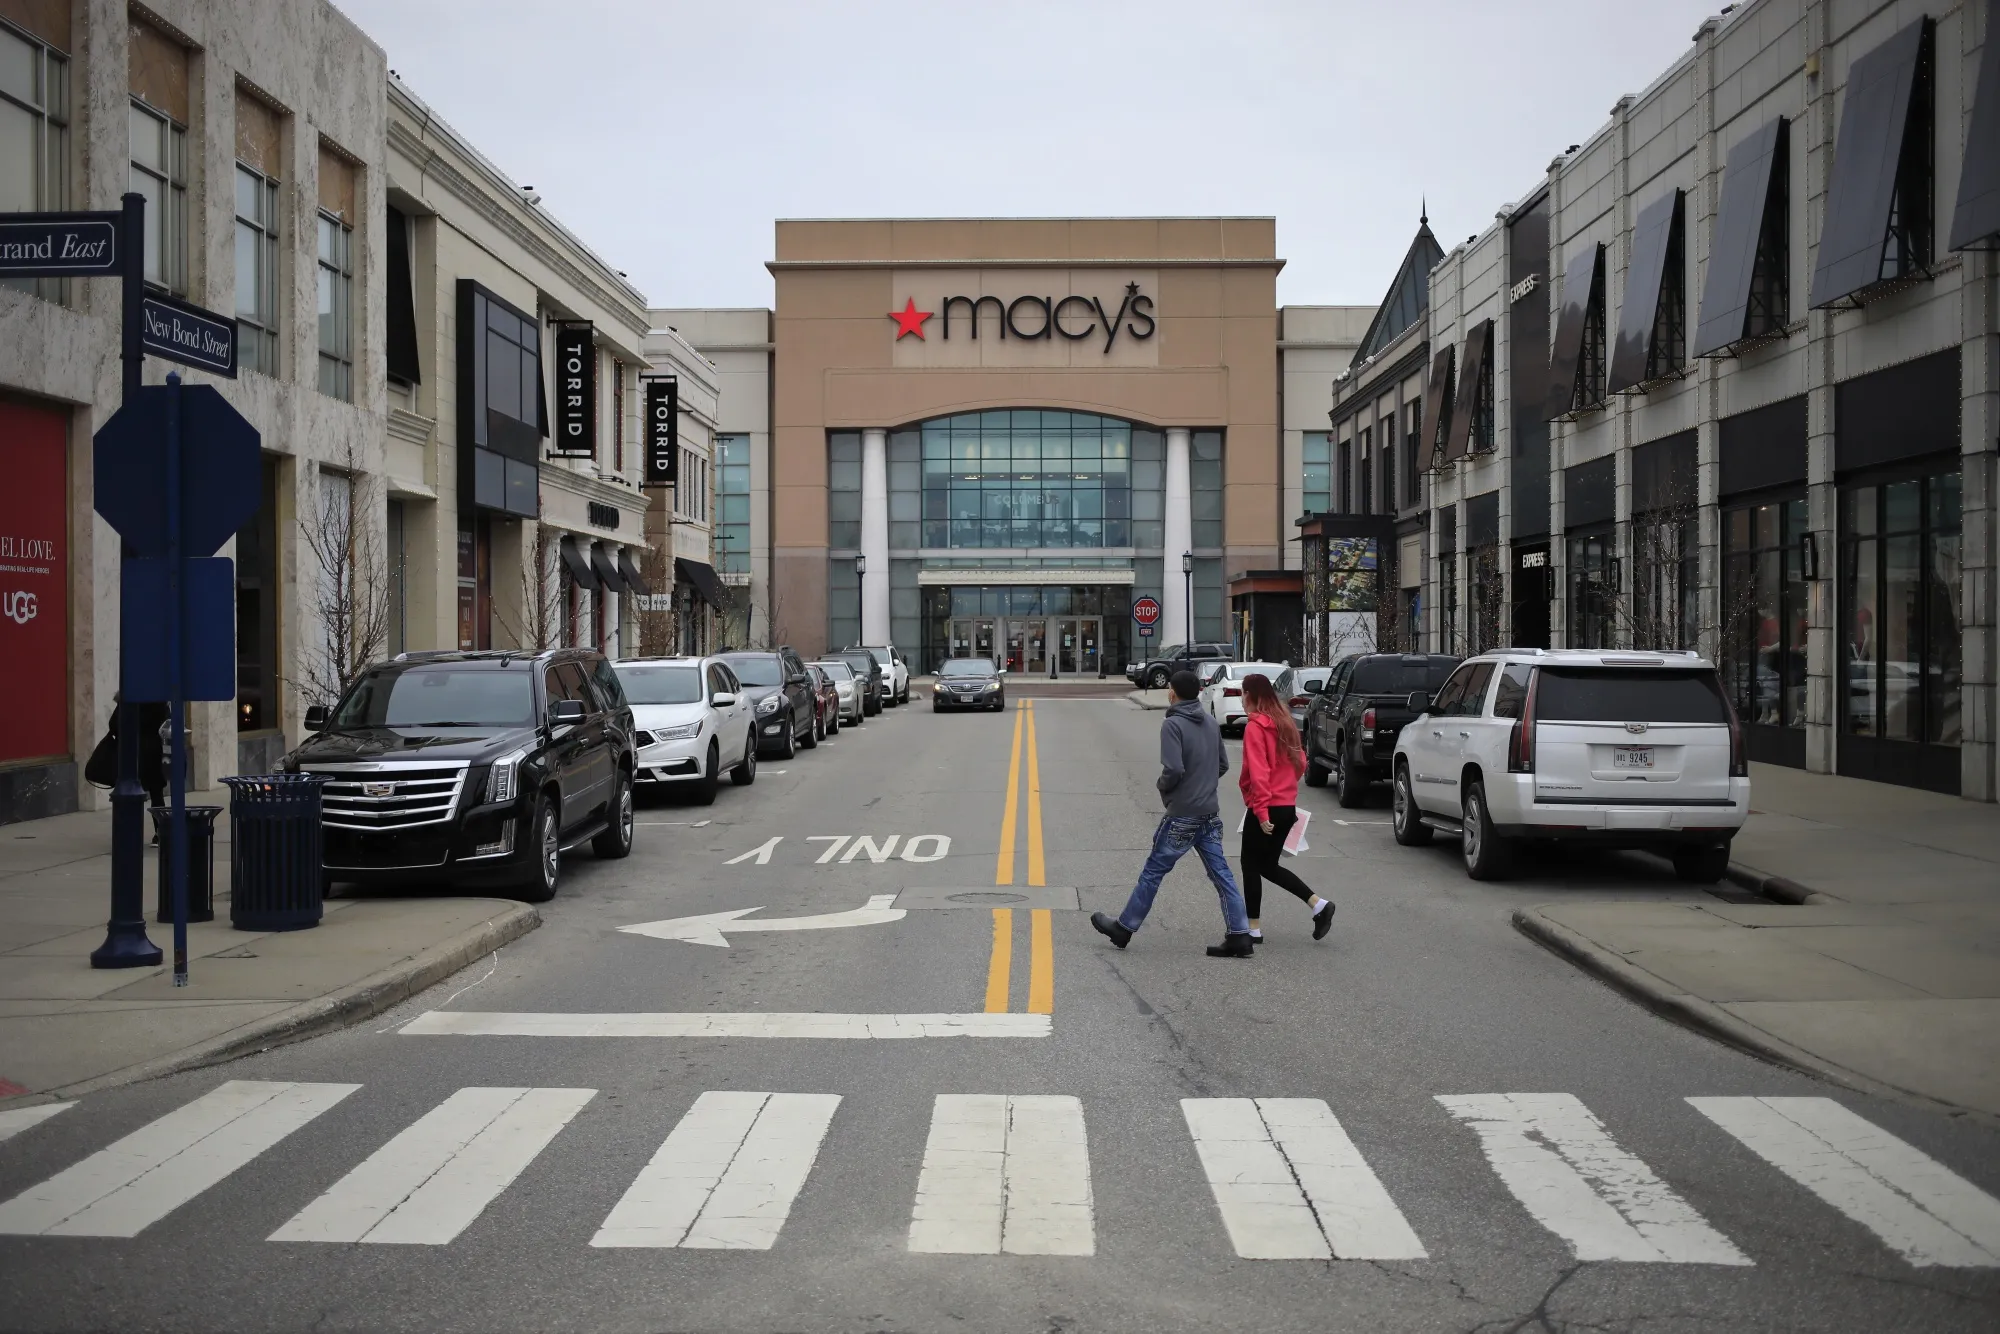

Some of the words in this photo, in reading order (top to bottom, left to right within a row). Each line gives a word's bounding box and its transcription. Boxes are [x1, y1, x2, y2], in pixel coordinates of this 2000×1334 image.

[60, 233, 107, 258] East
[1511, 273, 1535, 304] EXPRESS
[145, 309, 171, 340] New
[173, 318, 199, 349] Bond
[202, 330, 229, 358] Street
[567, 344, 582, 436] TORRID
[656, 395, 668, 470] TORRID
[20, 538, 56, 560] LOVE.
[1523, 552, 1544, 568] EXPRESS
[4, 591, 37, 624] UGG
[1136, 607, 1157, 616] STOP
[1629, 753, 1648, 763] 9245
[722, 834, 952, 864] ONLY
